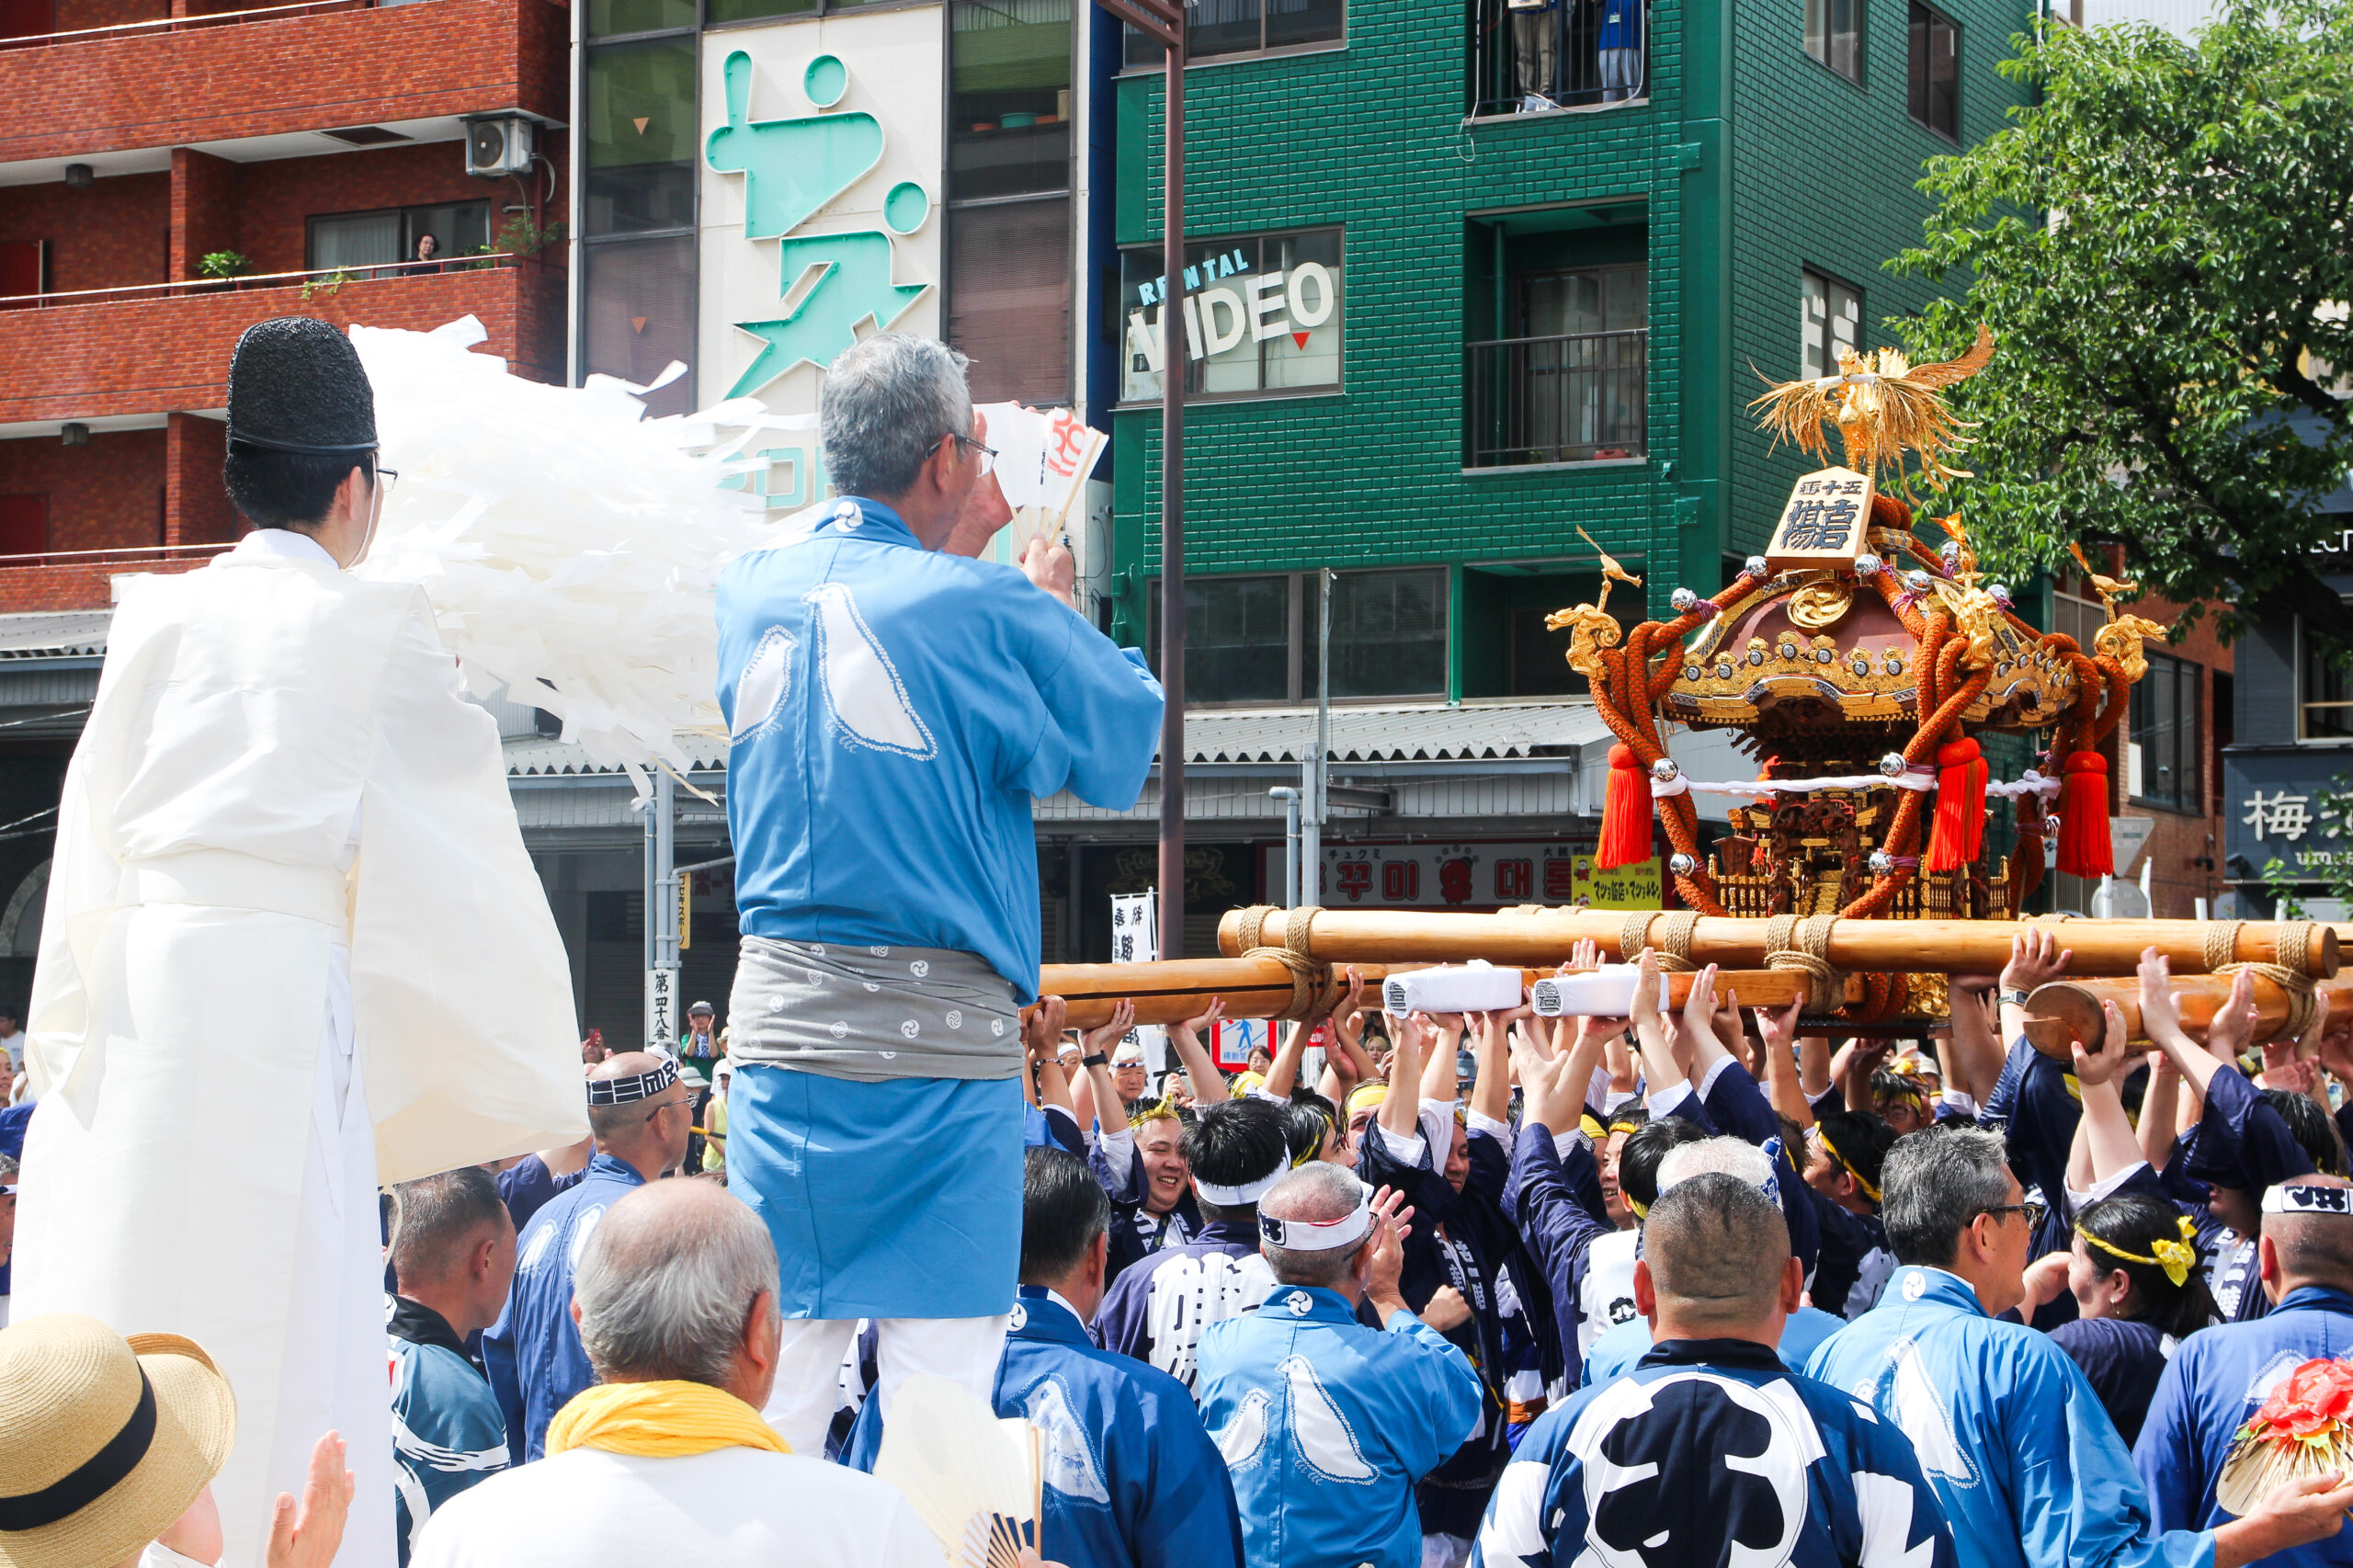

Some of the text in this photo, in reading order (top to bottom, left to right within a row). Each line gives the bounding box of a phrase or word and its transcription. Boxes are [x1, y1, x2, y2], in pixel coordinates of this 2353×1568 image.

[1129, 262, 1335, 373] VIDEO
[654, 972, 671, 1040] 第四十八番
